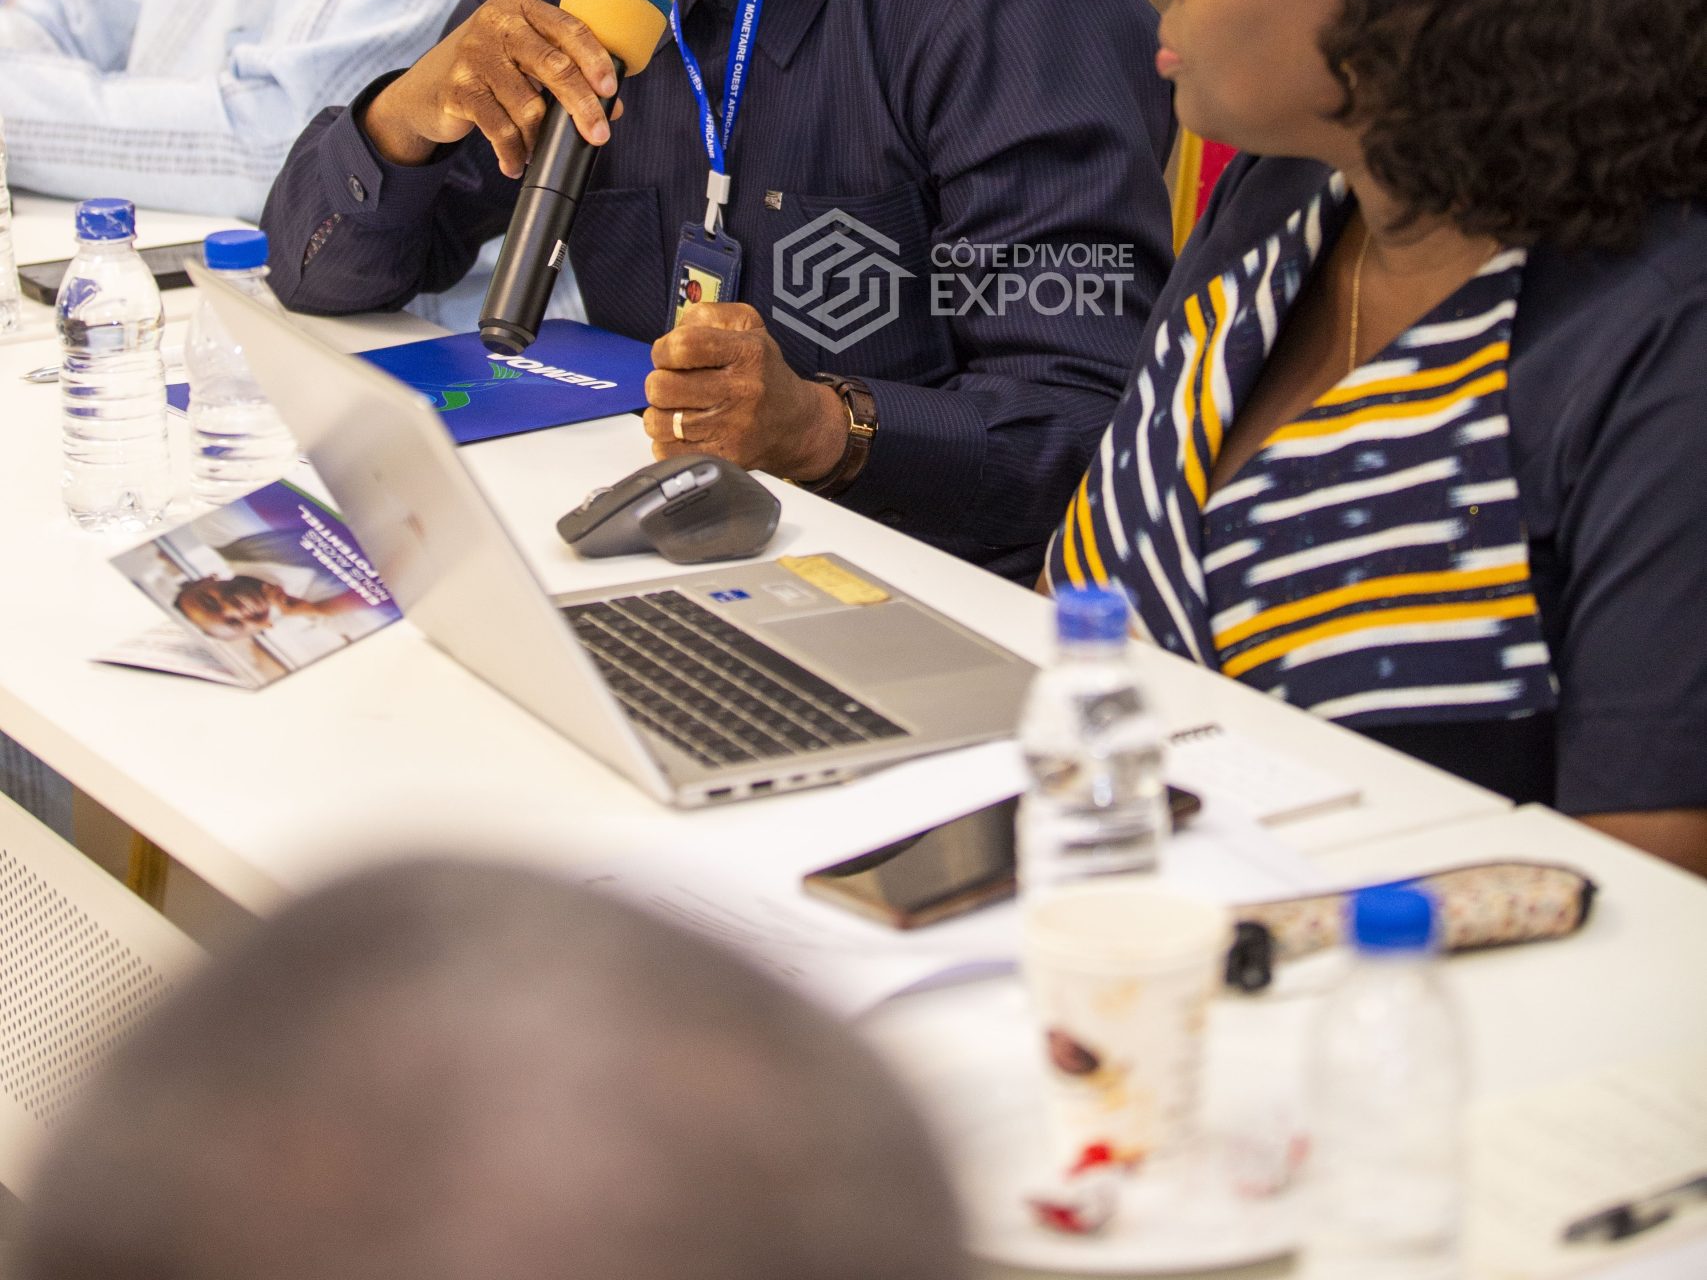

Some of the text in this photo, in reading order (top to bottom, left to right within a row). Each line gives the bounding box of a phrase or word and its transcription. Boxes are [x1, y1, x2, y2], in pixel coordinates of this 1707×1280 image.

[735, 3, 756, 62] MONETAIRE
[686, 65, 703, 96] OUES
[730, 63, 744, 98] OUEST
[302, 529, 354, 569] AVONS
[350, 566, 390, 602] NOUS
